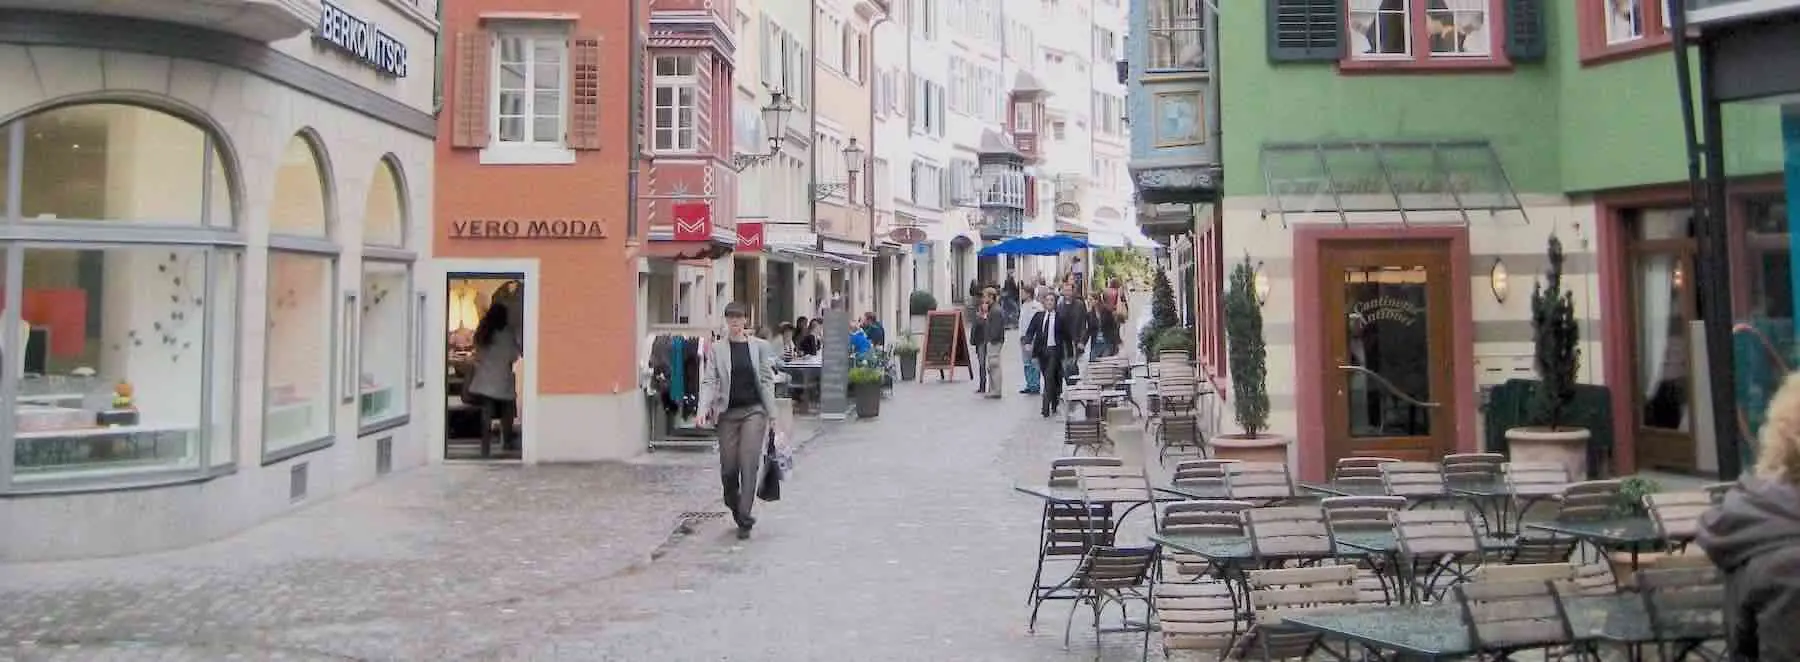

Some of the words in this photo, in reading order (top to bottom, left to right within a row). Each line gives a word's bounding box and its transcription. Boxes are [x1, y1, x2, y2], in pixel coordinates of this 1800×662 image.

[323, 4, 407, 77] BERKOWITSCH
[453, 219, 519, 237] VERO
[527, 219, 603, 237] MODA
